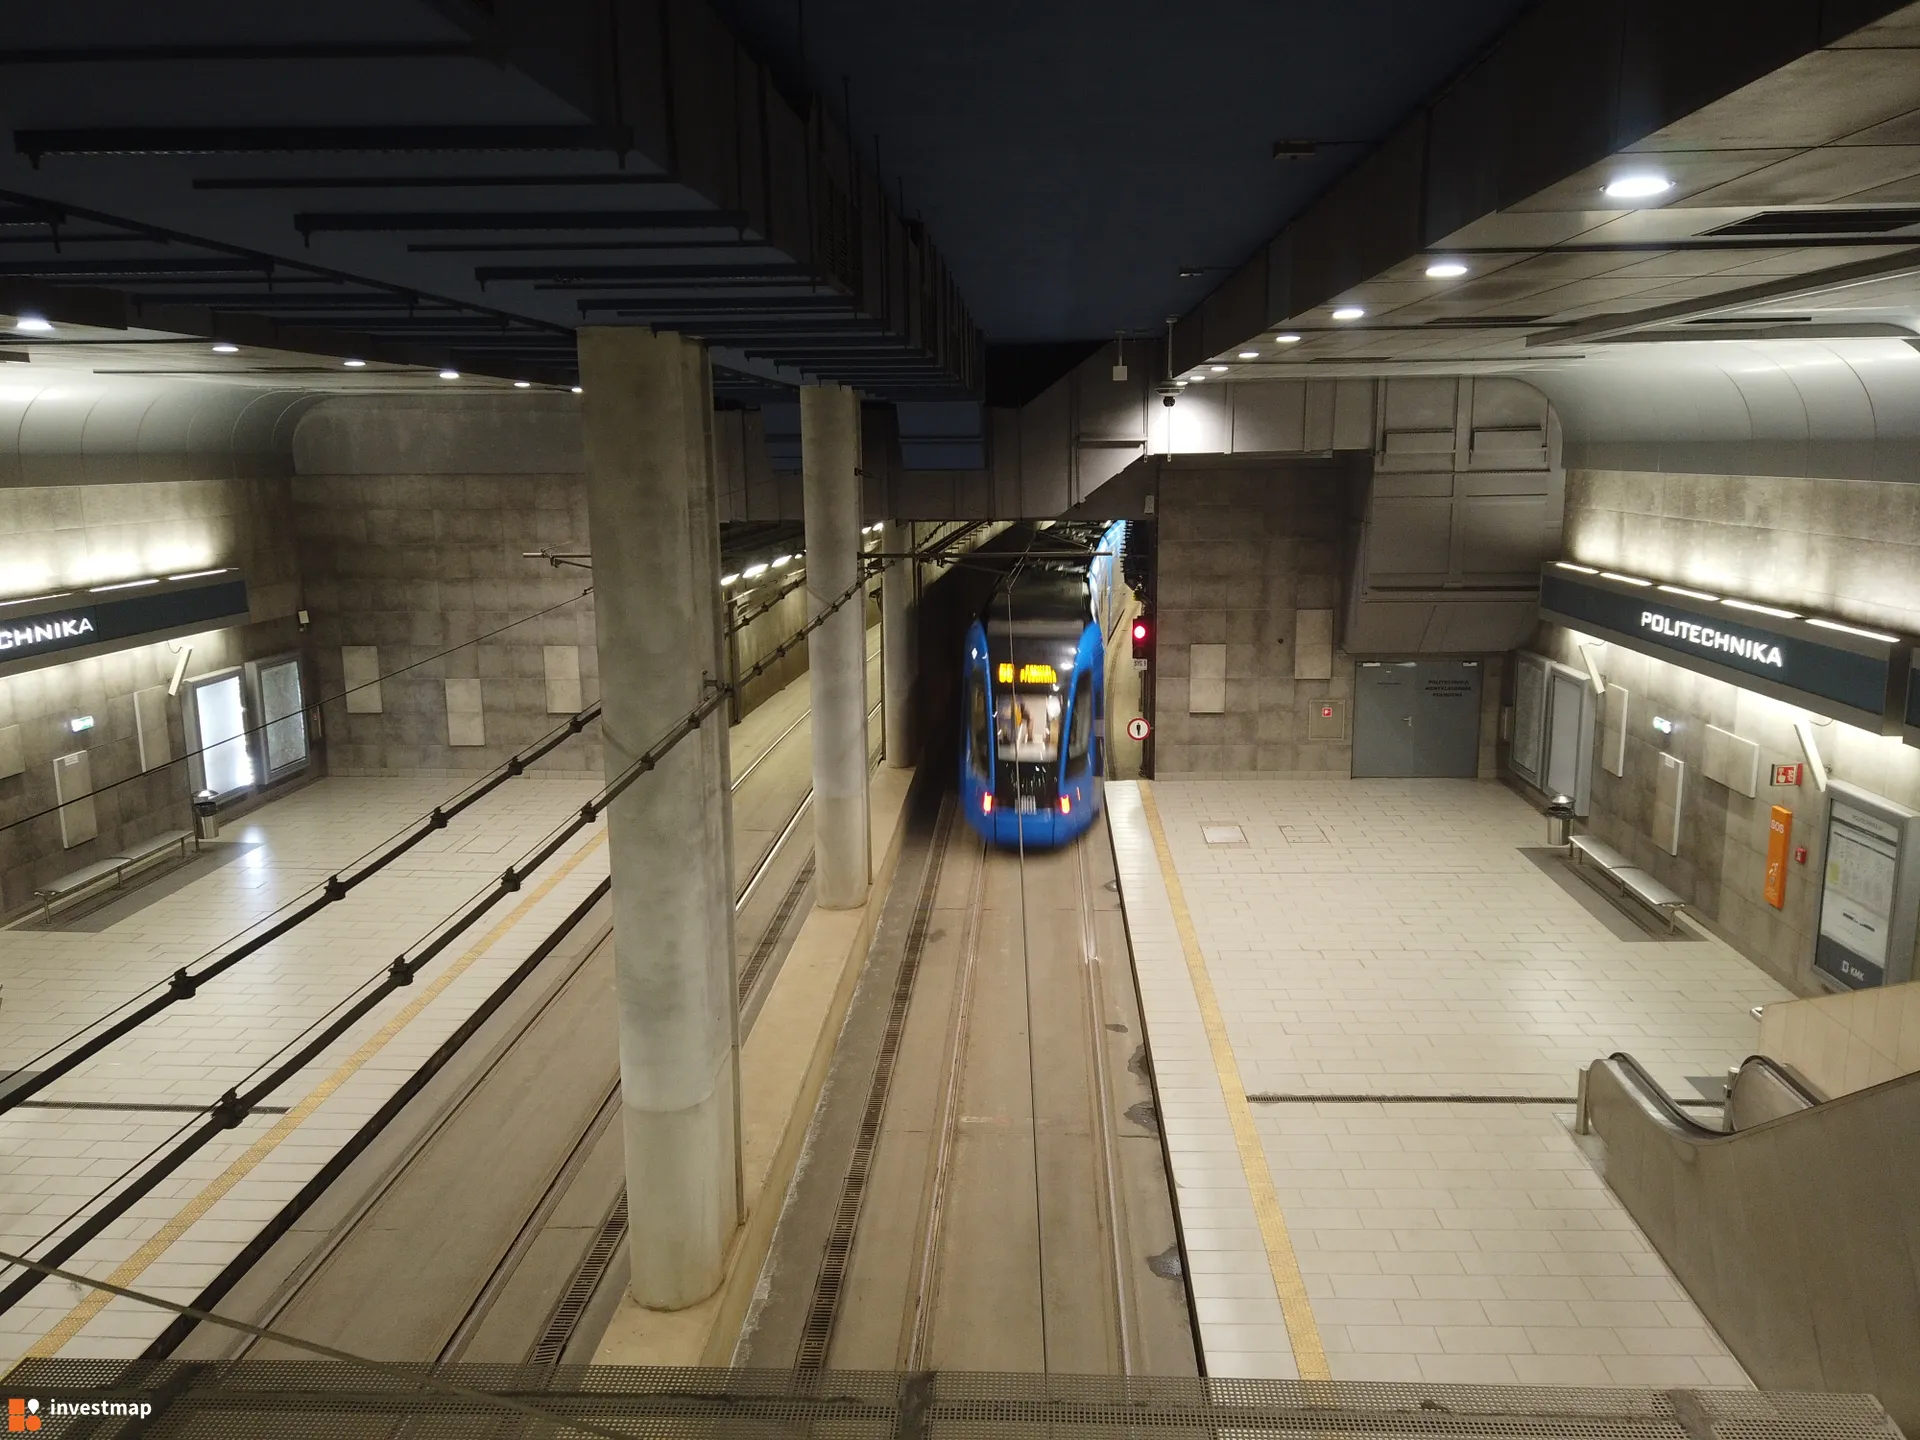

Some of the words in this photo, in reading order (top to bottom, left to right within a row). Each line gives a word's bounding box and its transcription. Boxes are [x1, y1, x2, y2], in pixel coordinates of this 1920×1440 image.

[1640, 611, 1783, 668] POLITECHNIKA
[1770, 819, 1785, 834] SOS
[1850, 967, 1865, 982] KMK
